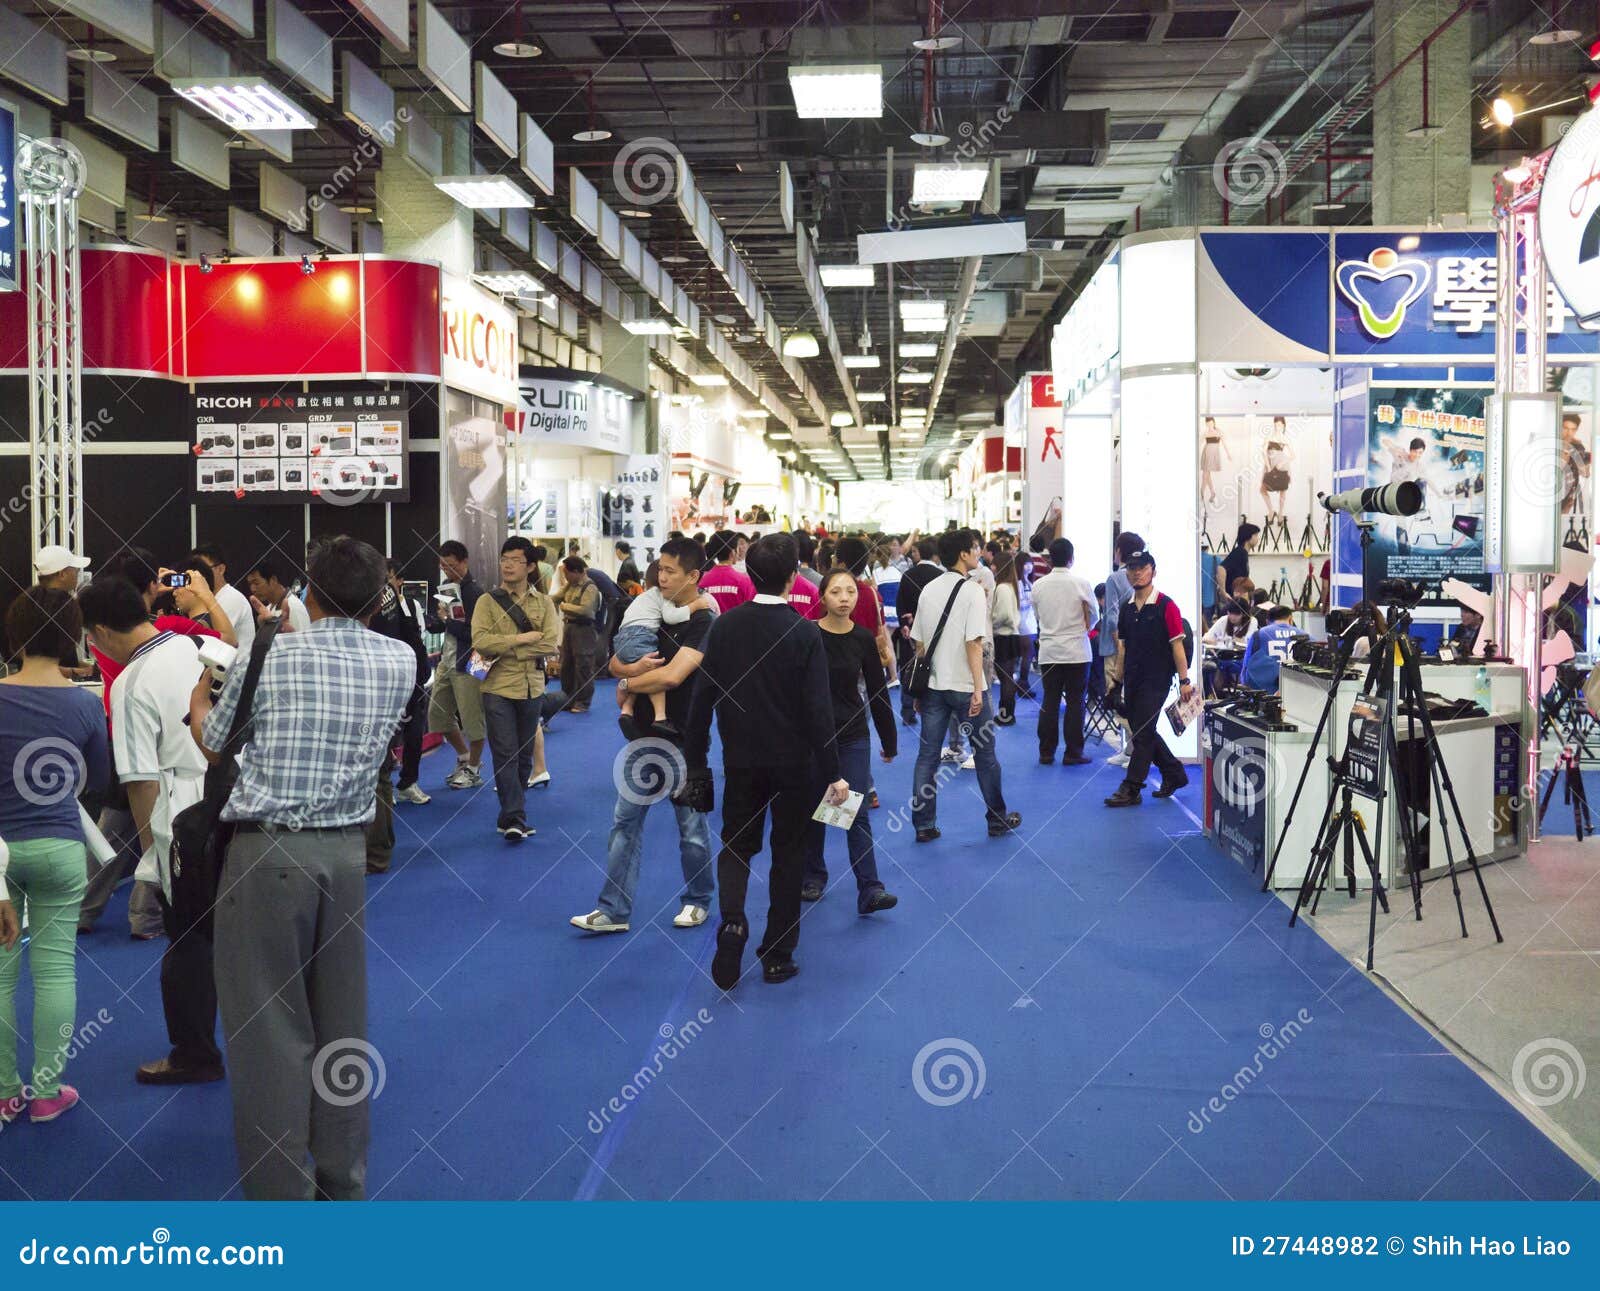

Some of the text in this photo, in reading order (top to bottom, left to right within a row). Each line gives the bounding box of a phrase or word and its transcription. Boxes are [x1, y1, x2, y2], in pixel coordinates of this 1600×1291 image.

[196, 397, 252, 409] RICOH
[530, 412, 570, 432] Digital
[573, 415, 588, 432] Pro
